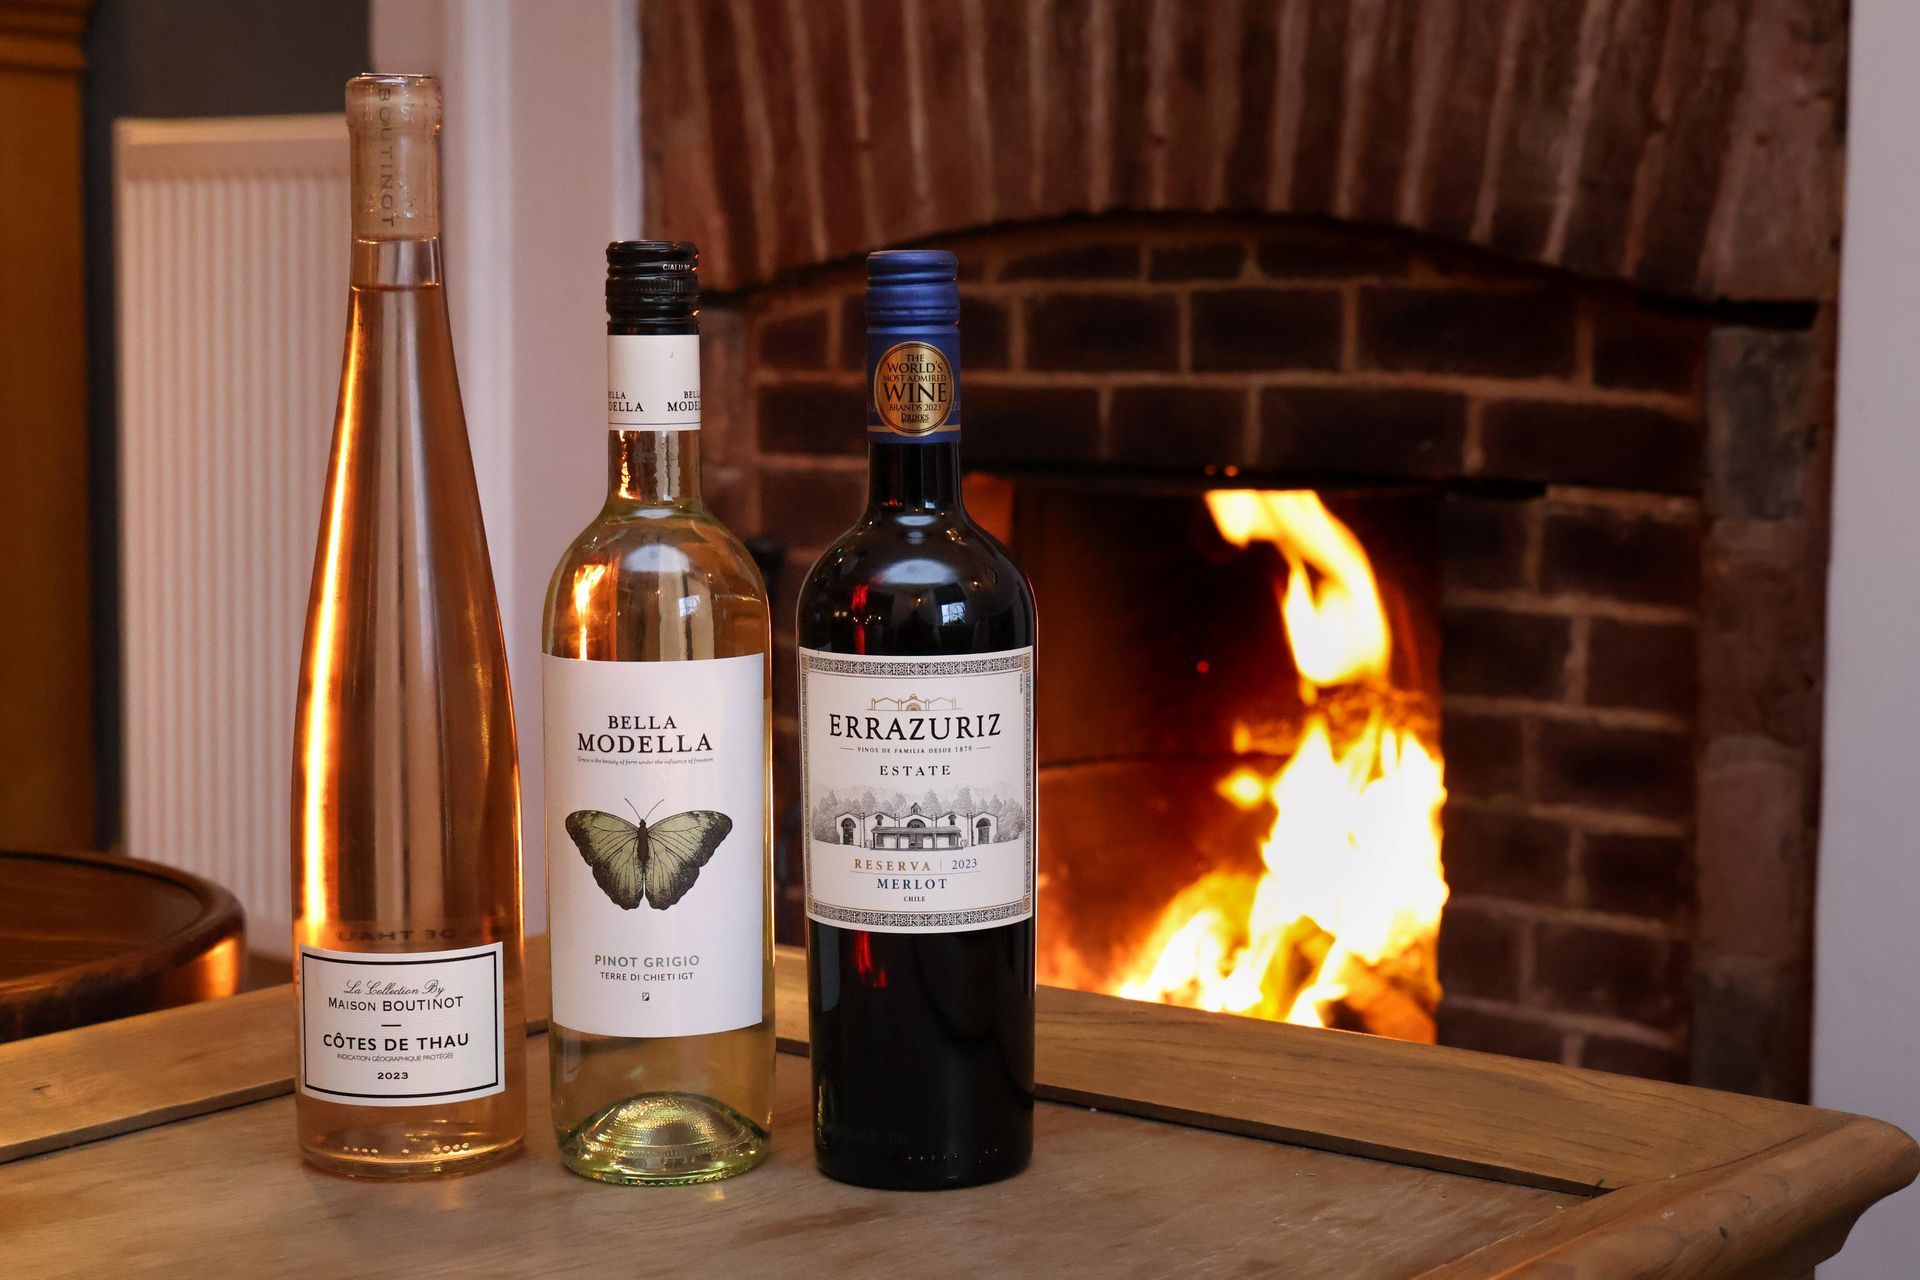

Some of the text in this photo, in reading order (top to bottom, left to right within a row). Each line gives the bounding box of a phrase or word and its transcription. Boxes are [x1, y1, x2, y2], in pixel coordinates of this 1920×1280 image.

[379, 88, 394, 228] BOUTINOT
[906, 354, 925, 362] THE
[887, 360, 943, 374] WORLD'S
[883, 374, 947, 383] MOST ADMIRED
[883, 382, 947, 403] WINE
[889, 403, 922, 412] BRANDS
[924, 403, 942, 412] 2023
[608, 715, 678, 730] BELLA
[829, 713, 1002, 741] ERRAZURIZ
[577, 733, 713, 754] MODELLA
[955, 745, 973, 753] 1870
[880, 765, 951, 777] ESTATE
[854, 858, 978, 872] RESERVA 2023
[877, 878, 948, 890] MERLOT
[595, 954, 700, 968] PINOT GRIGIO
[600, 971, 694, 982] TERRE DI CHIETI IGT
[343, 979, 446, 997] La Collection By
[328, 995, 463, 1012] MAISON BOUTINOT
[323, 1031, 469, 1051] CÔTES DE THAU
[377, 1071, 409, 1080] 2023
